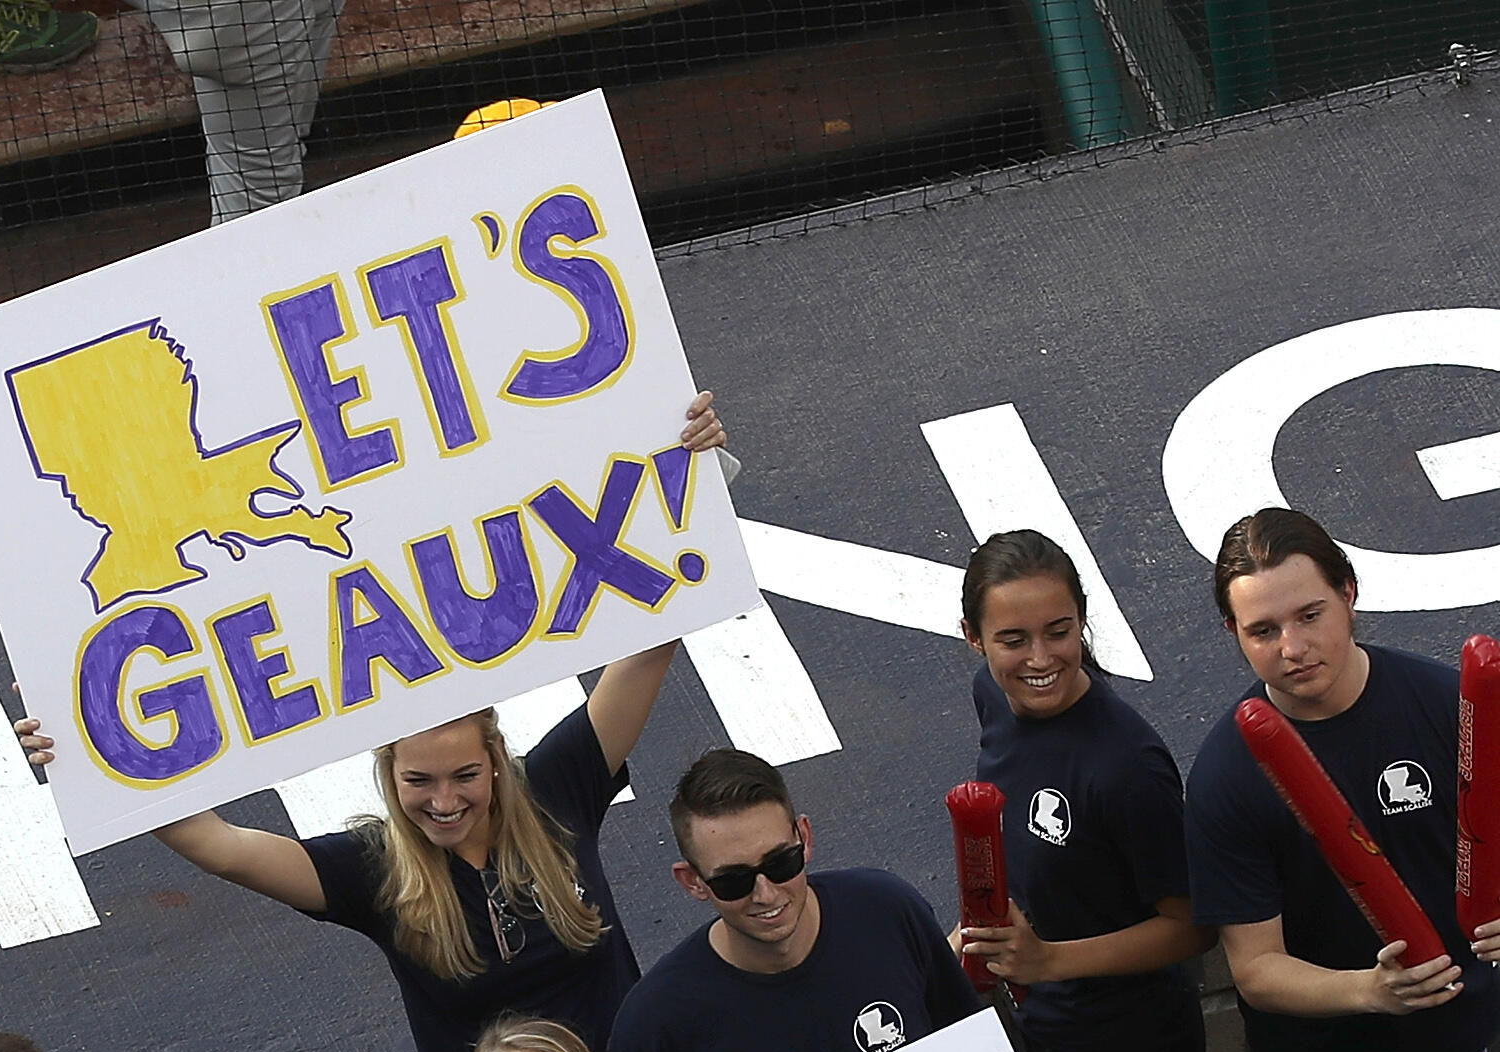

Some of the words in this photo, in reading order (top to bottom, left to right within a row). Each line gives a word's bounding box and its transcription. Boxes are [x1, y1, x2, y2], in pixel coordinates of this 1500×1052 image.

[73, 446, 708, 789] GEAUX!
[1382, 805, 1403, 816] TEAM
[1403, 799, 1433, 812] SCALISE
[882, 1034, 906, 1052] SCALISE
